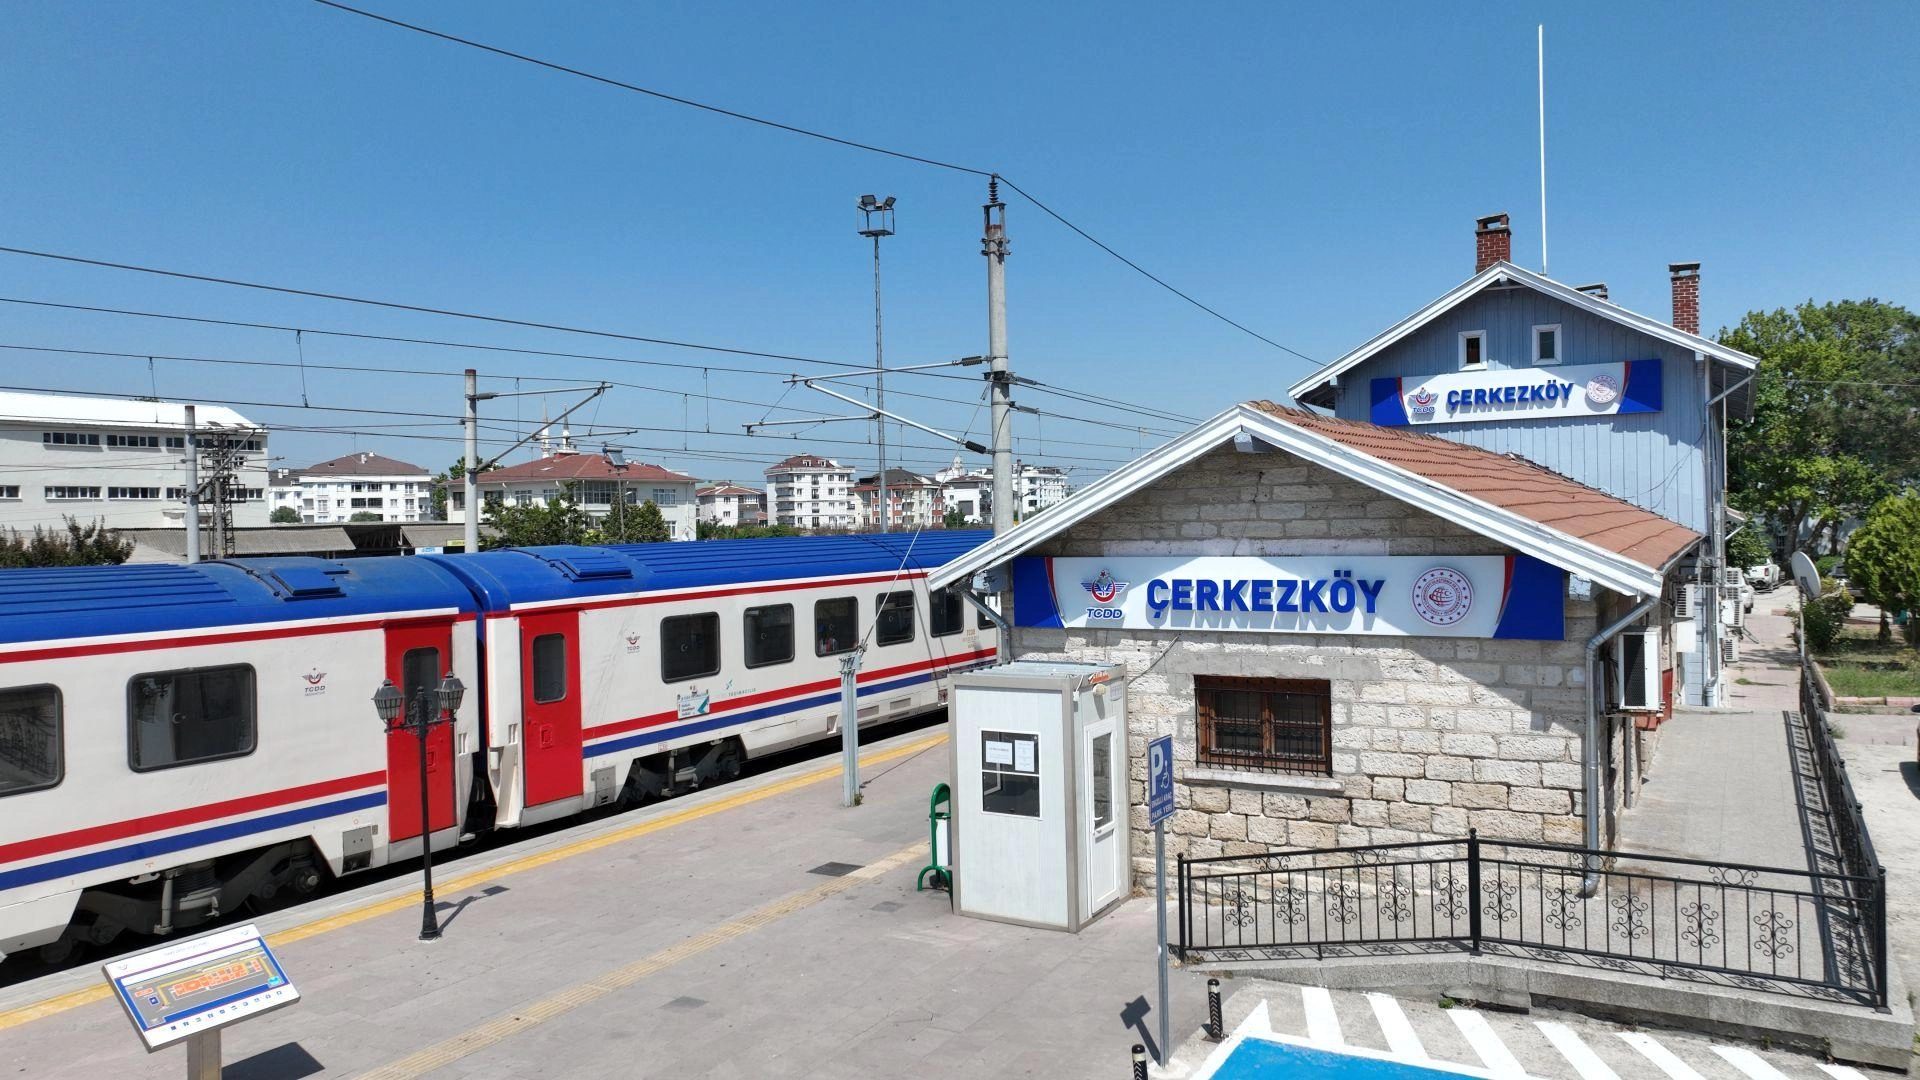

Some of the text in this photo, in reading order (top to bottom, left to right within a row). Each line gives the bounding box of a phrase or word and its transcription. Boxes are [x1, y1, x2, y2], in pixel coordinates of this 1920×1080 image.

[1447, 380, 1574, 409] ÇERKEZKÖY
[1147, 570, 1385, 618] ÇERKEZKÖY
[1086, 608, 1123, 619] TCDD
[1151, 744, 1164, 796] P
